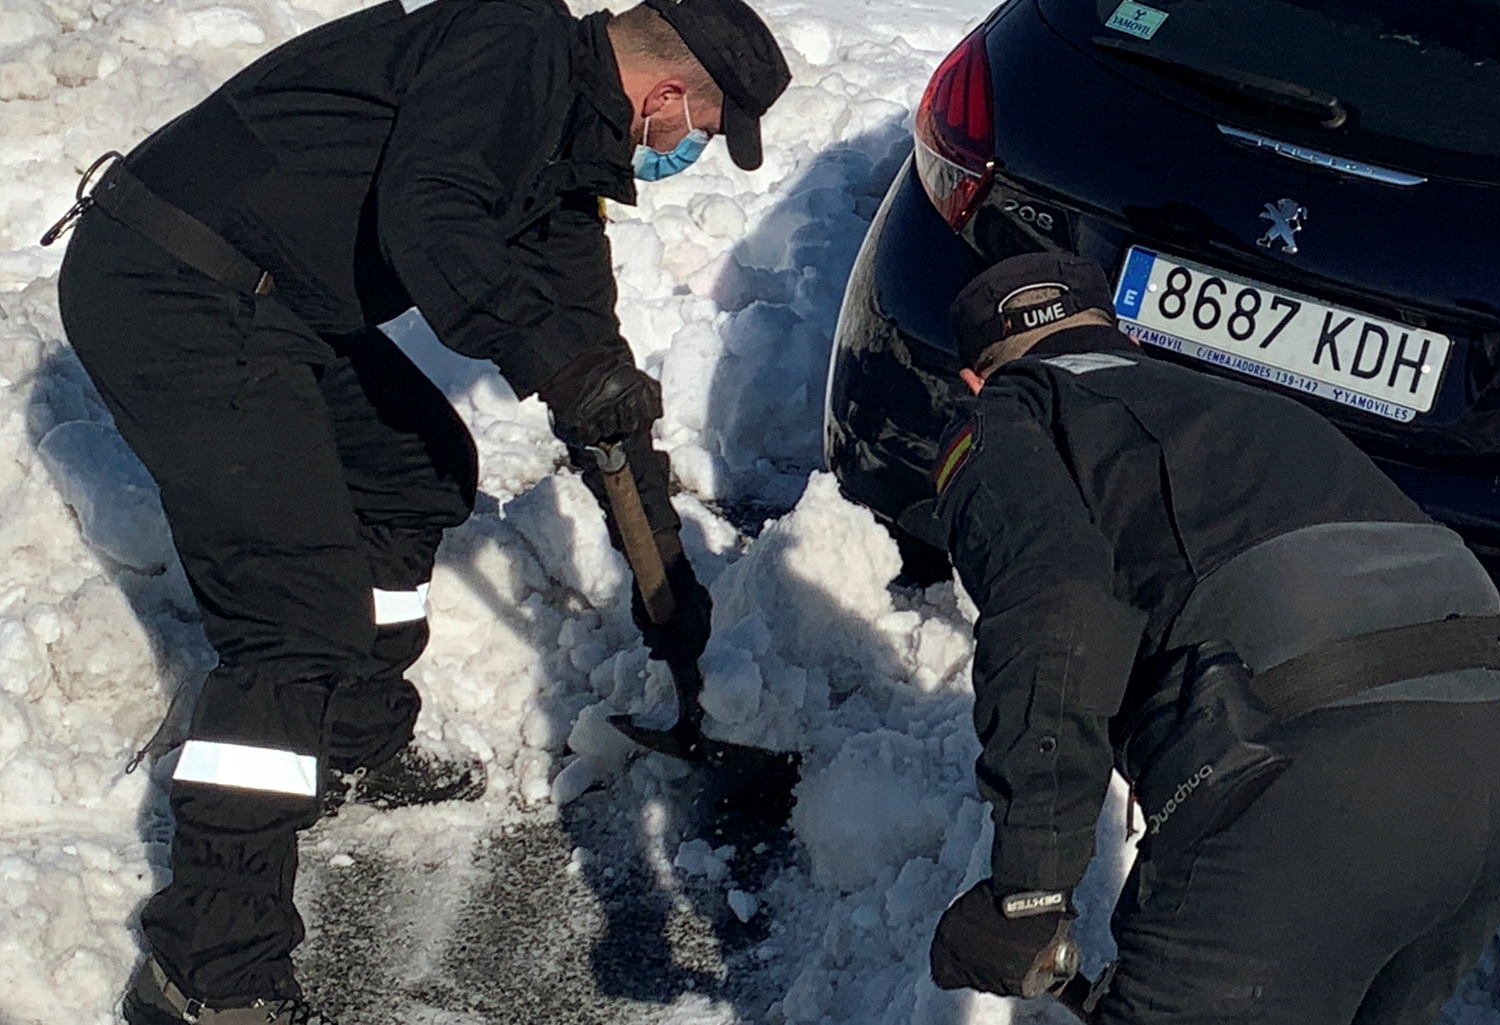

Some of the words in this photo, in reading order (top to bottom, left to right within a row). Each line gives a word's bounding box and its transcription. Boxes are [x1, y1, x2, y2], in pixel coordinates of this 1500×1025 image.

[1112, 15, 1151, 35] YAMOVIL
[1023, 302, 1066, 327] UME
[1123, 289, 1139, 307] E
[1158, 266, 1301, 349] 8687
[1312, 311, 1431, 394] KDH
[1135, 327, 1183, 352] YAMOVIL
[1196, 347, 1271, 377] C/EMBAJADORES
[1275, 371, 1318, 393] 139-147
[1343, 392, 1409, 420] YAMOVIL.ES
[1150, 764, 1214, 834] Quechua
